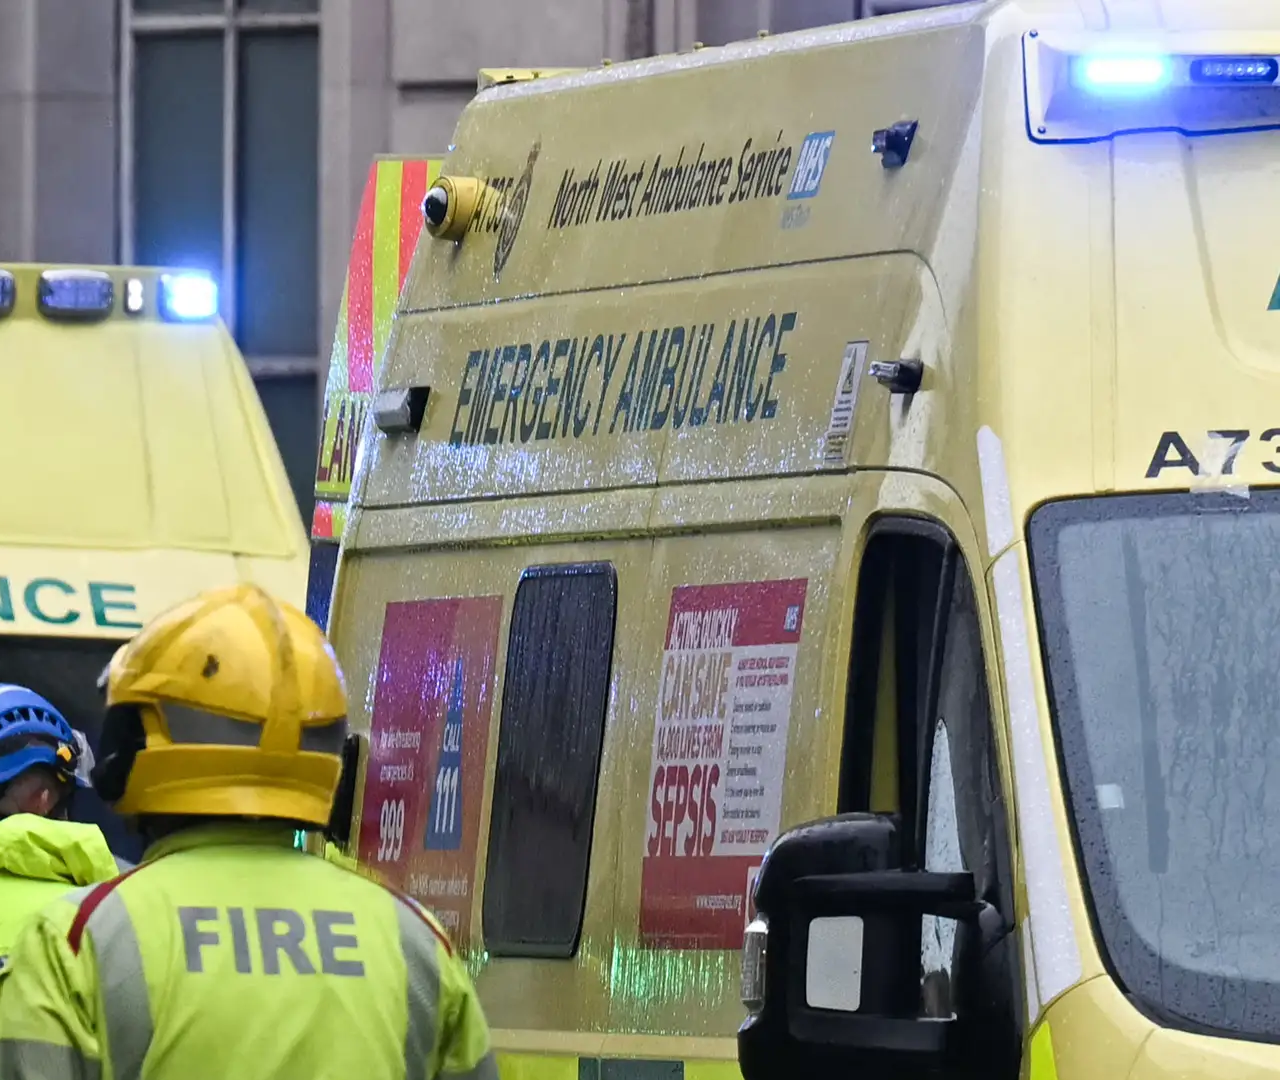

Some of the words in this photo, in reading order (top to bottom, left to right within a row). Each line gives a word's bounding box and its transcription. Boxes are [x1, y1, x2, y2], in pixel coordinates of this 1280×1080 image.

[547, 158, 602, 229] North
[595, 158, 646, 222] West
[636, 142, 733, 217] Ambulance
[728, 128, 792, 204] Service
[788, 133, 834, 195] NHS
[449, 332, 627, 447] EMERGENCY
[608, 311, 798, 435] AMBULANCE
[668, 610, 702, 650] ACTING
[701, 607, 739, 649] QUICKLY
[661, 653, 696, 721] CAN
[692, 651, 732, 720] SAVE
[442, 723, 460, 752] CALL
[680, 724, 702, 760] LIVES
[701, 723, 725, 760] FROM
[377, 798, 405, 862] 999
[435, 766, 459, 834] 111
[647, 763, 721, 857] SEPSIS
[178, 906, 366, 977] FIRE
